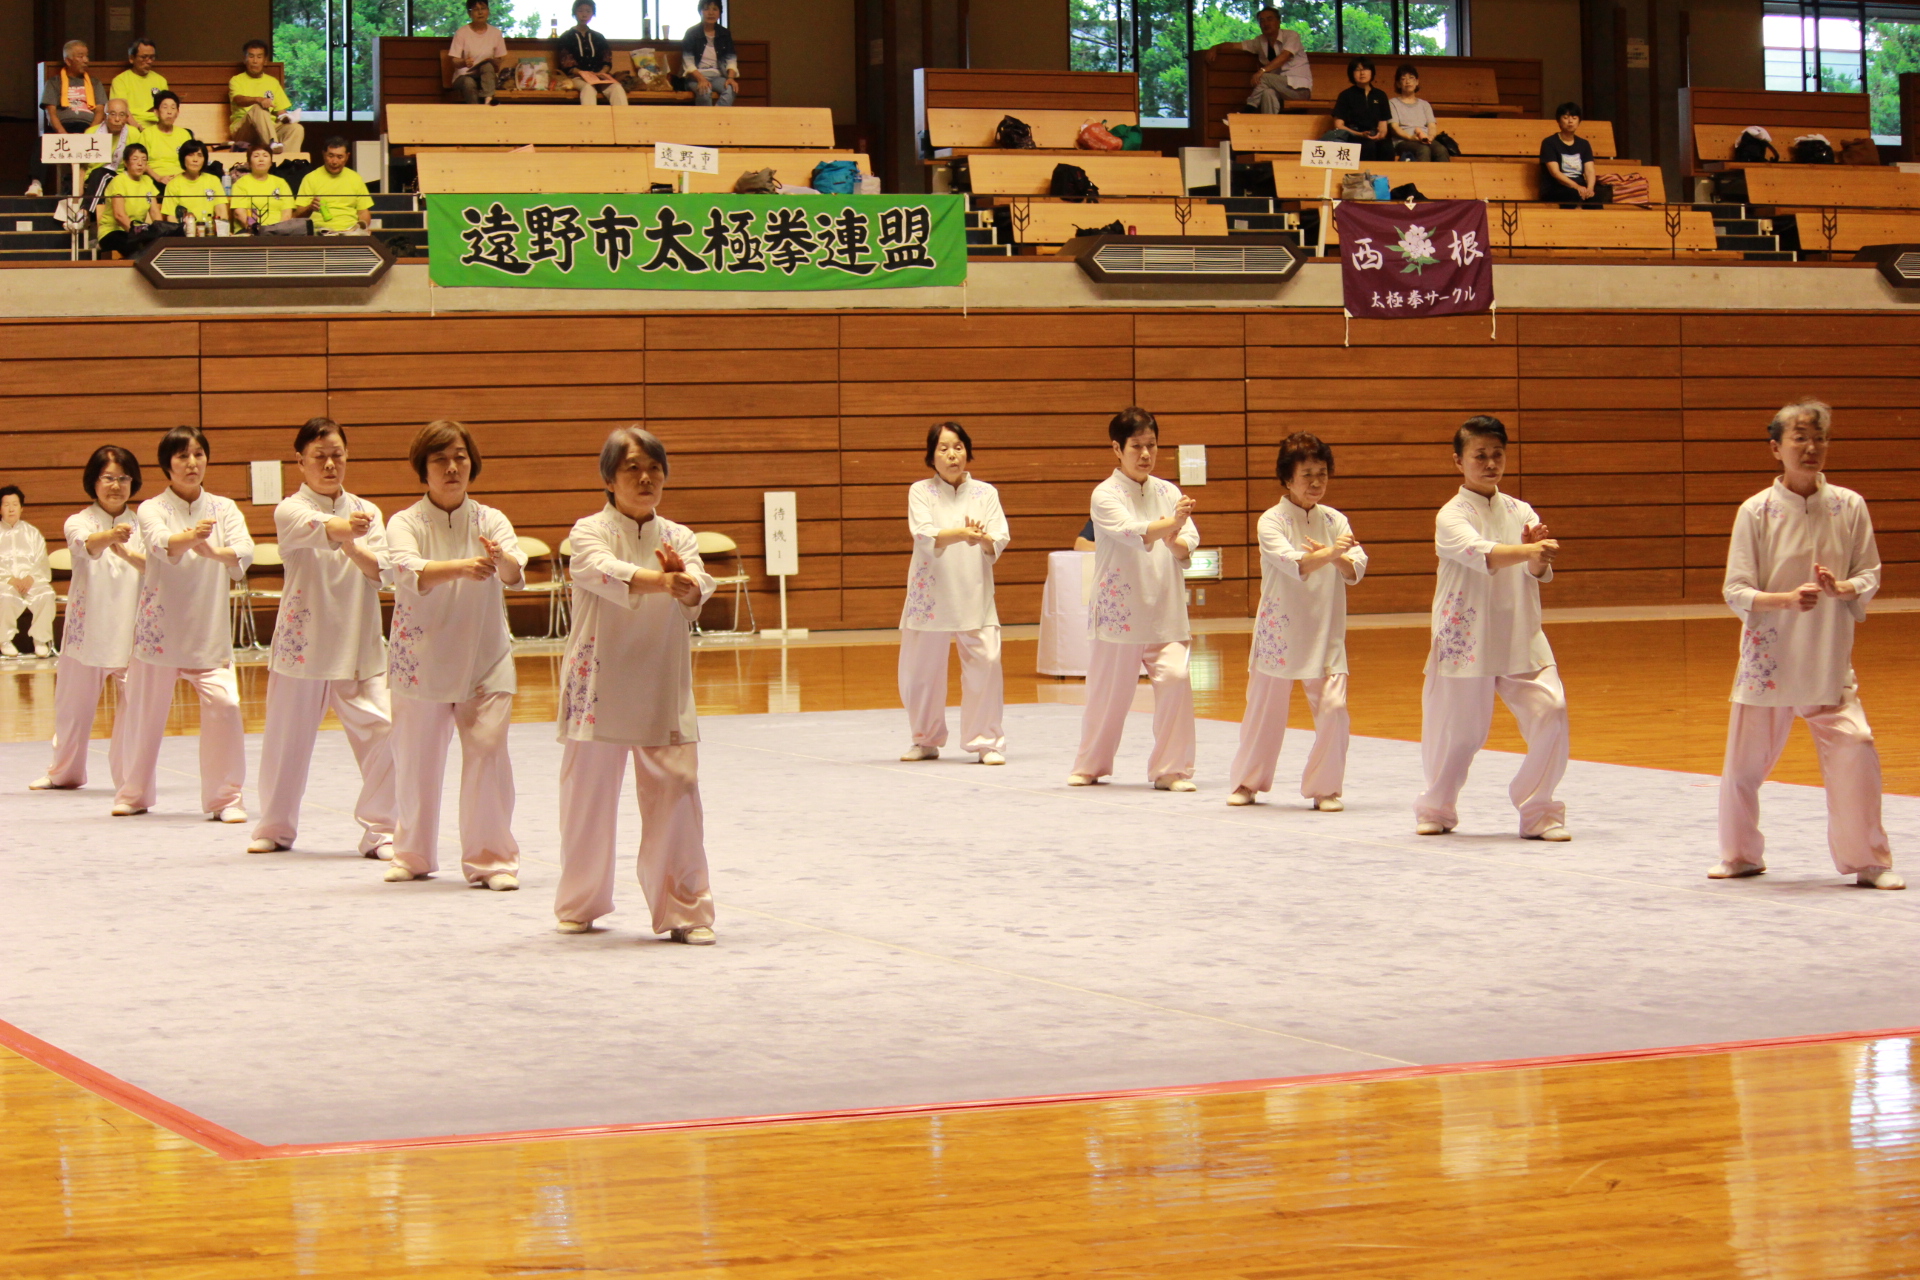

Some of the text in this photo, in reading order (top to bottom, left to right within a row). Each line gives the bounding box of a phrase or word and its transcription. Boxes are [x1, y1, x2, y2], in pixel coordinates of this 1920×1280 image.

[54, 137, 100, 152] 北上
[1311, 145, 1351, 161] 西根
[660, 147, 711, 165] 遠野市
[460, 203, 936, 275] 遠野市太極拳連盟
[1370, 286, 1476, 309] 太極拳サークル
